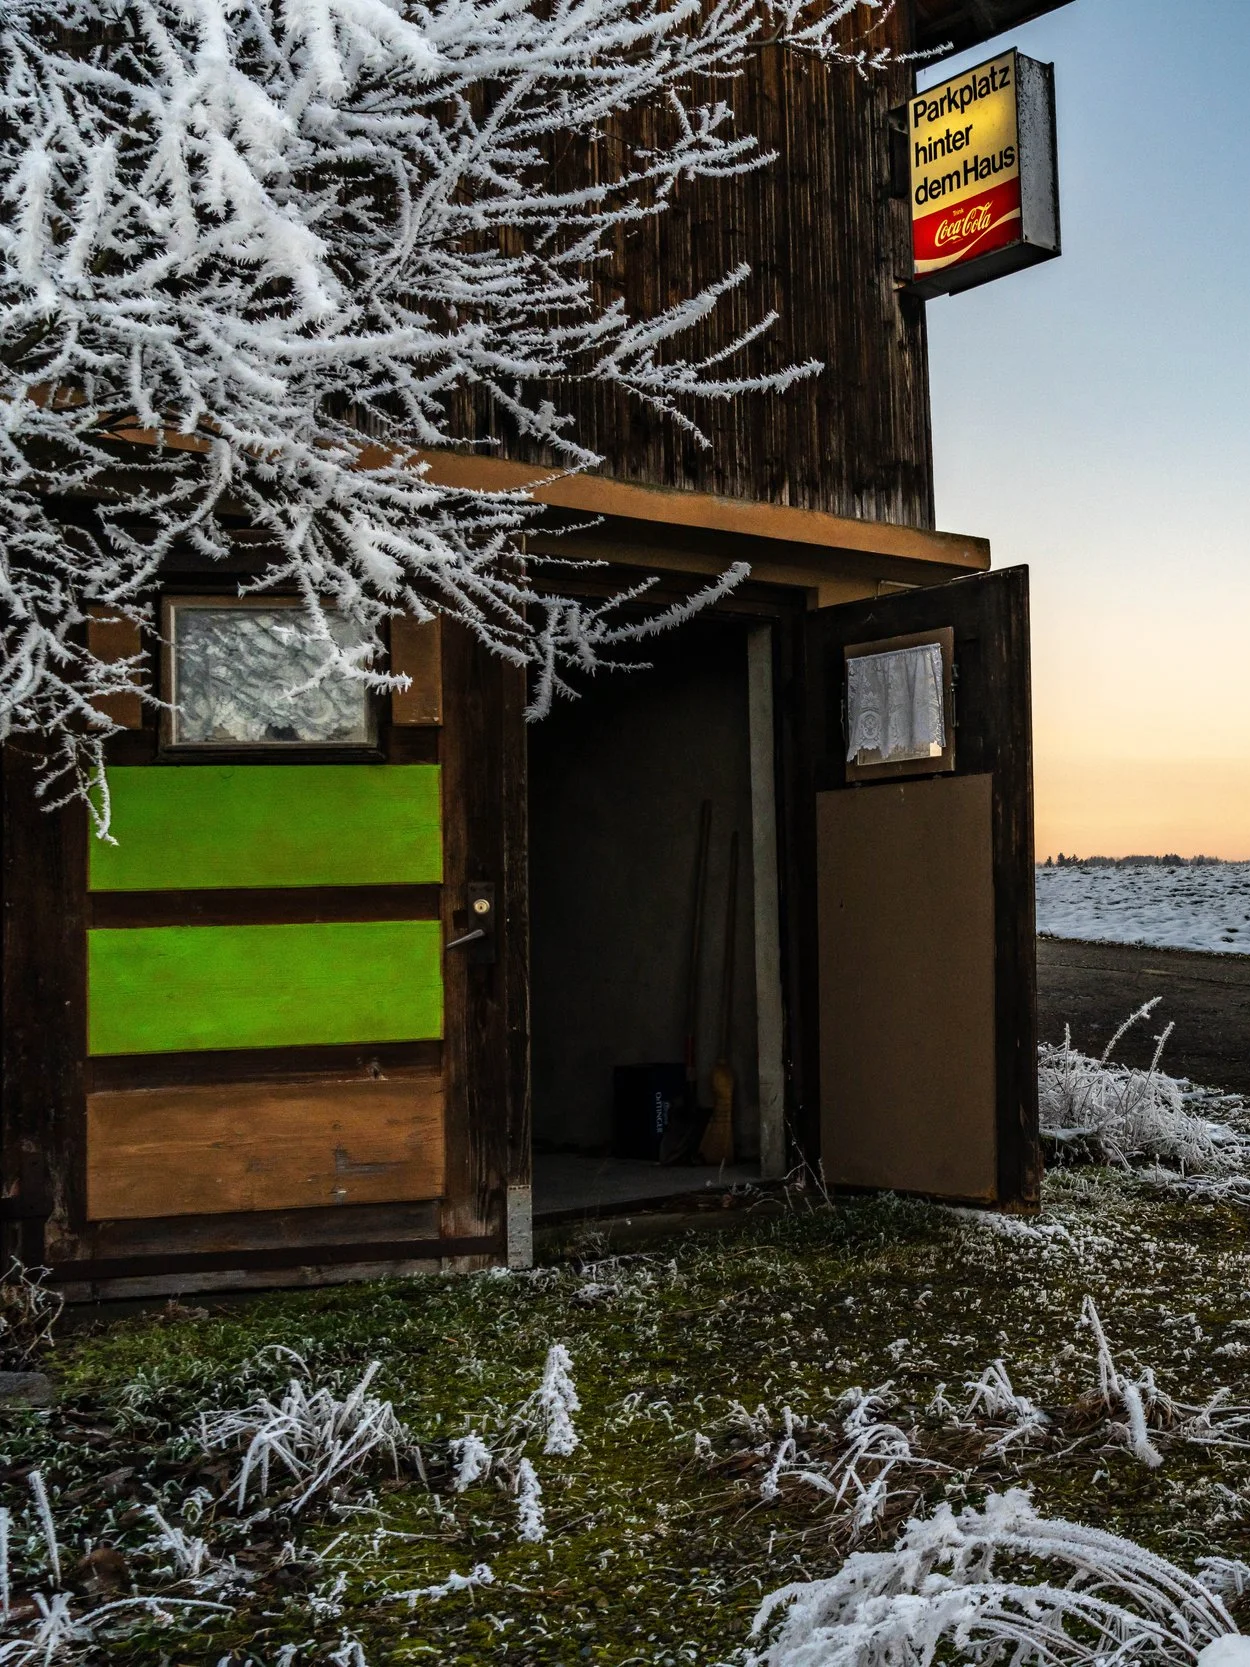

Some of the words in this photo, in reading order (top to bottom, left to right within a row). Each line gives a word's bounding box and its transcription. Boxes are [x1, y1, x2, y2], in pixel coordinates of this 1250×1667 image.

[913, 65, 1011, 128] Parkplatz
[914, 124, 973, 168] hinter
[914, 169, 961, 206] dem
[963, 146, 1015, 186] Haus
[934, 200, 993, 247] Coca-Cola
